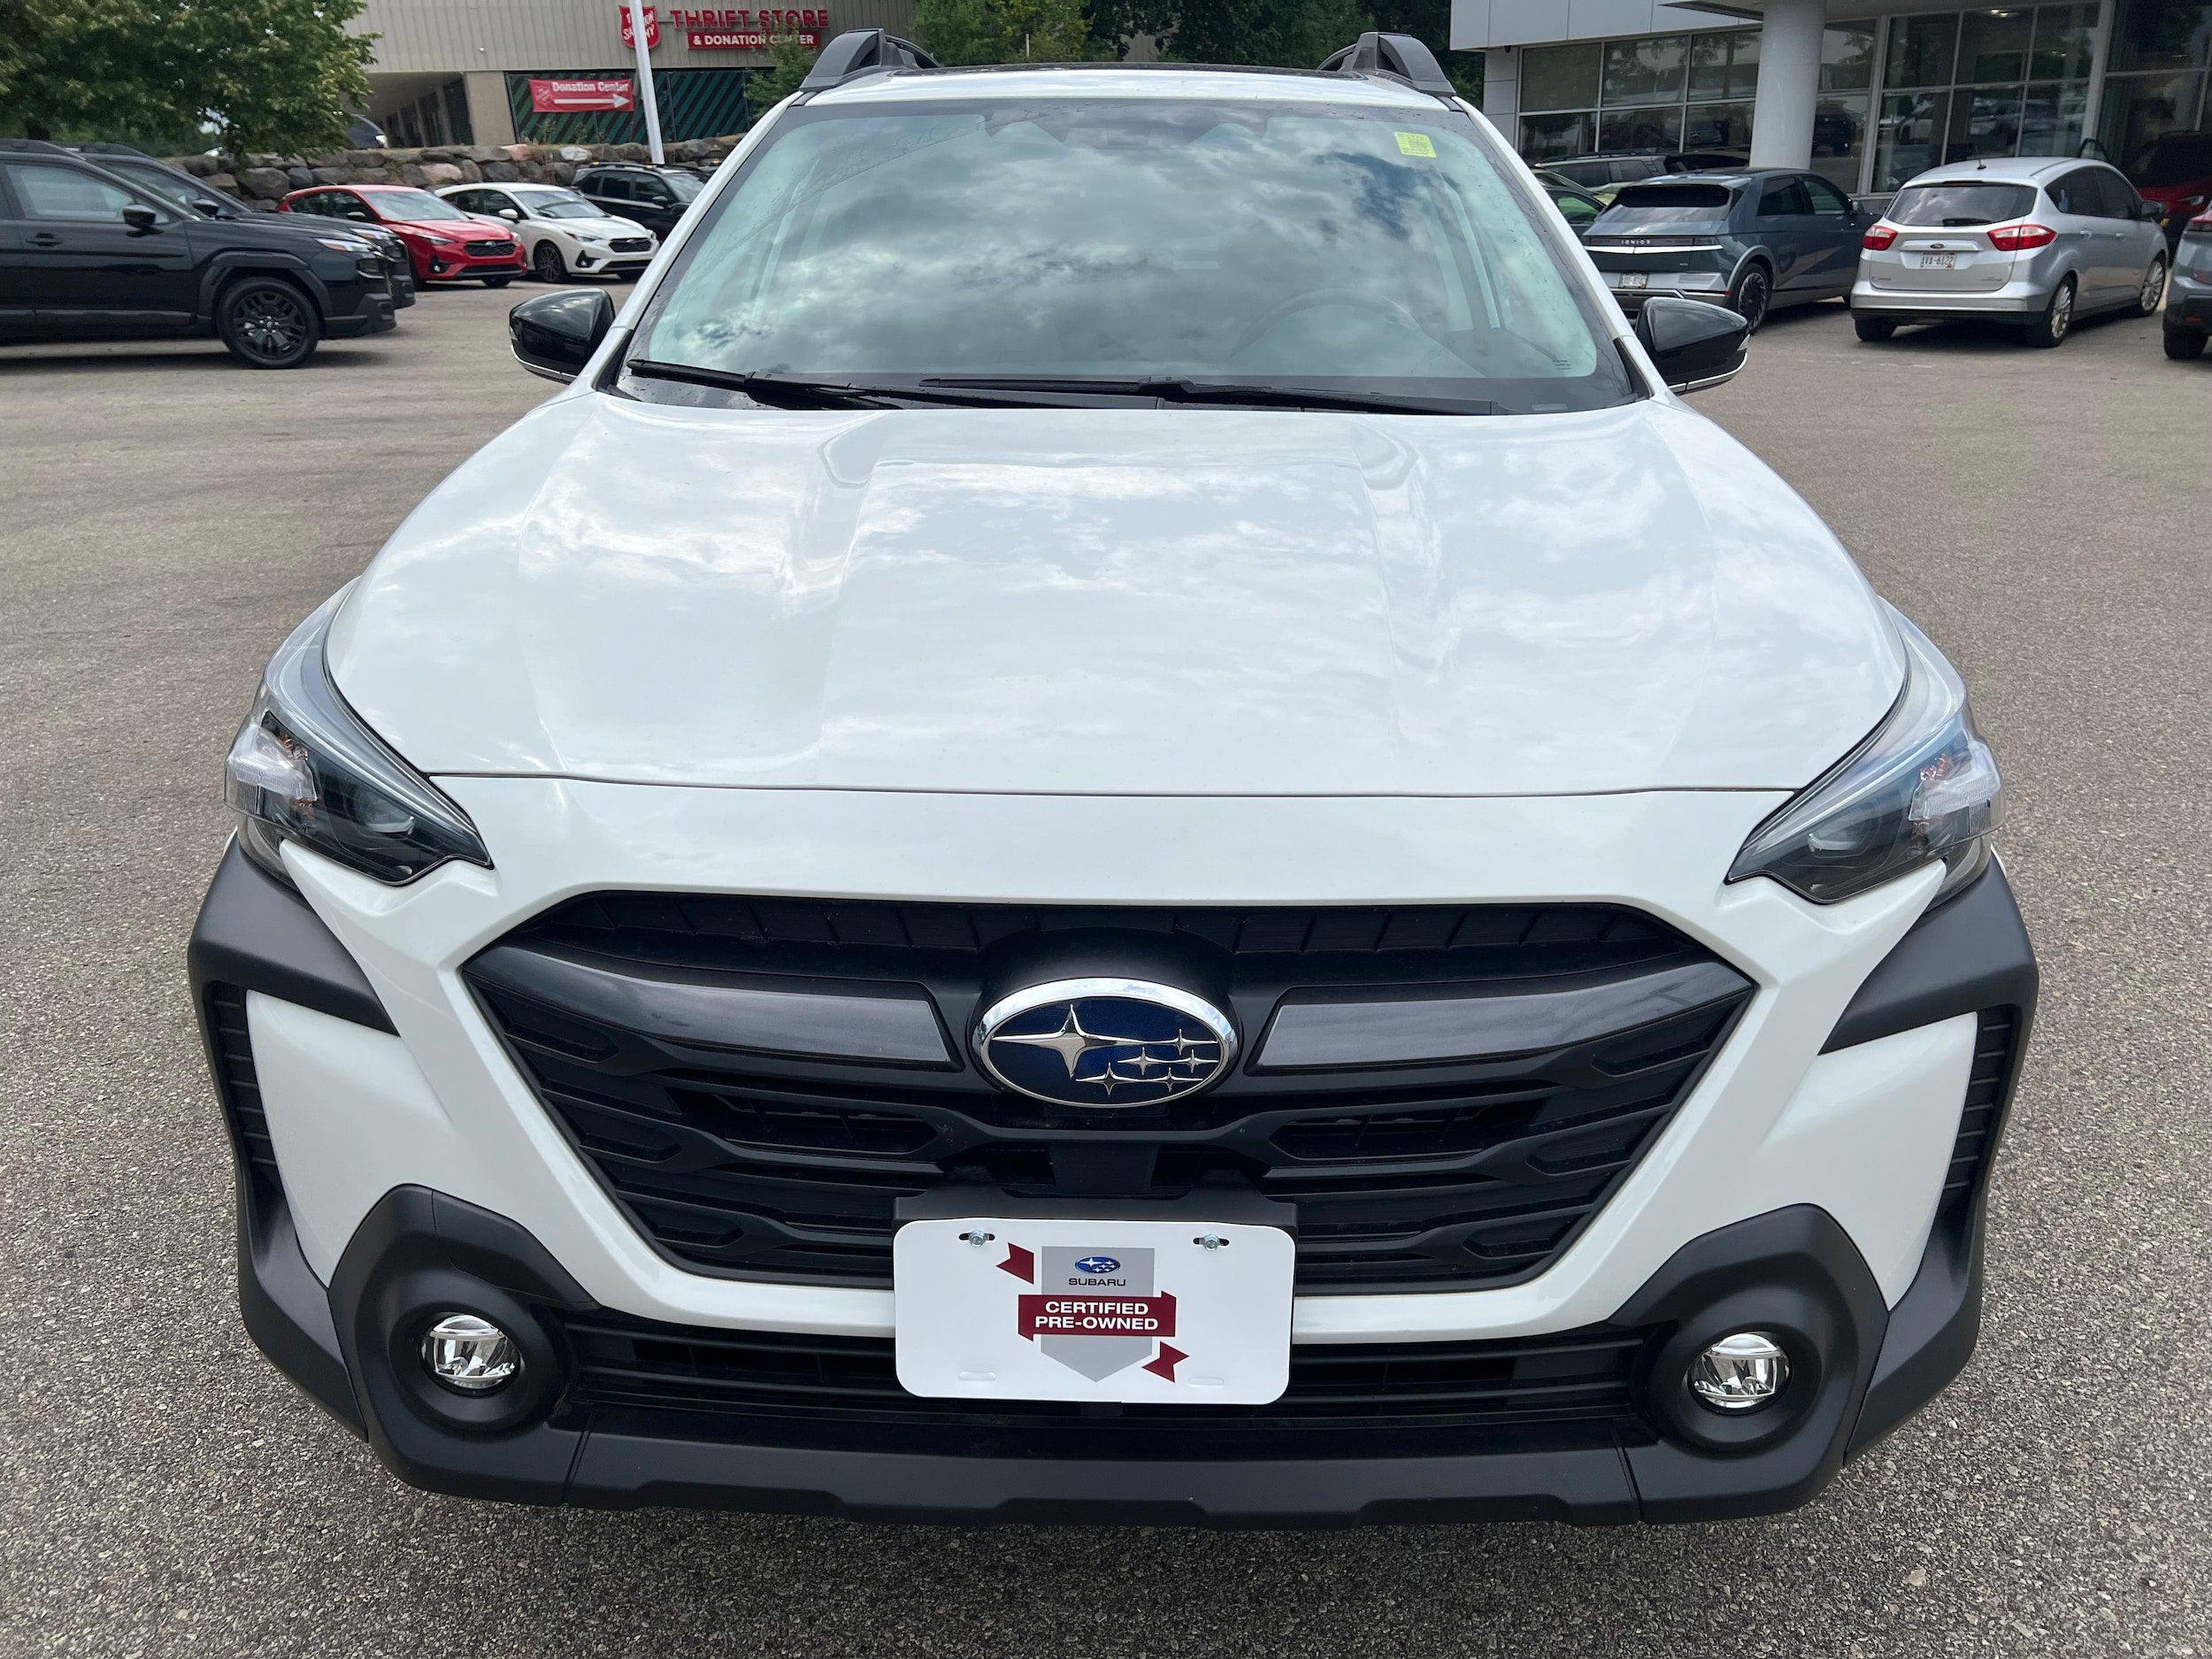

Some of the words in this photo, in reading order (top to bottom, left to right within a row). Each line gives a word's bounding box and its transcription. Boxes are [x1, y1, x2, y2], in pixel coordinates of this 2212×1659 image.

[670, 10, 749, 28] THRIFT
[758, 10, 830, 28] STORE
[693, 35, 702, 45] &
[704, 35, 766, 45] DONATION
[551, 81, 595, 92] Donation
[597, 81, 629, 92] Center
[1068, 1278, 1126, 1286] SUBARU
[1045, 1301, 1149, 1315] CERTIFIED
[1035, 1316, 1159, 1330] PRE-OWNED
